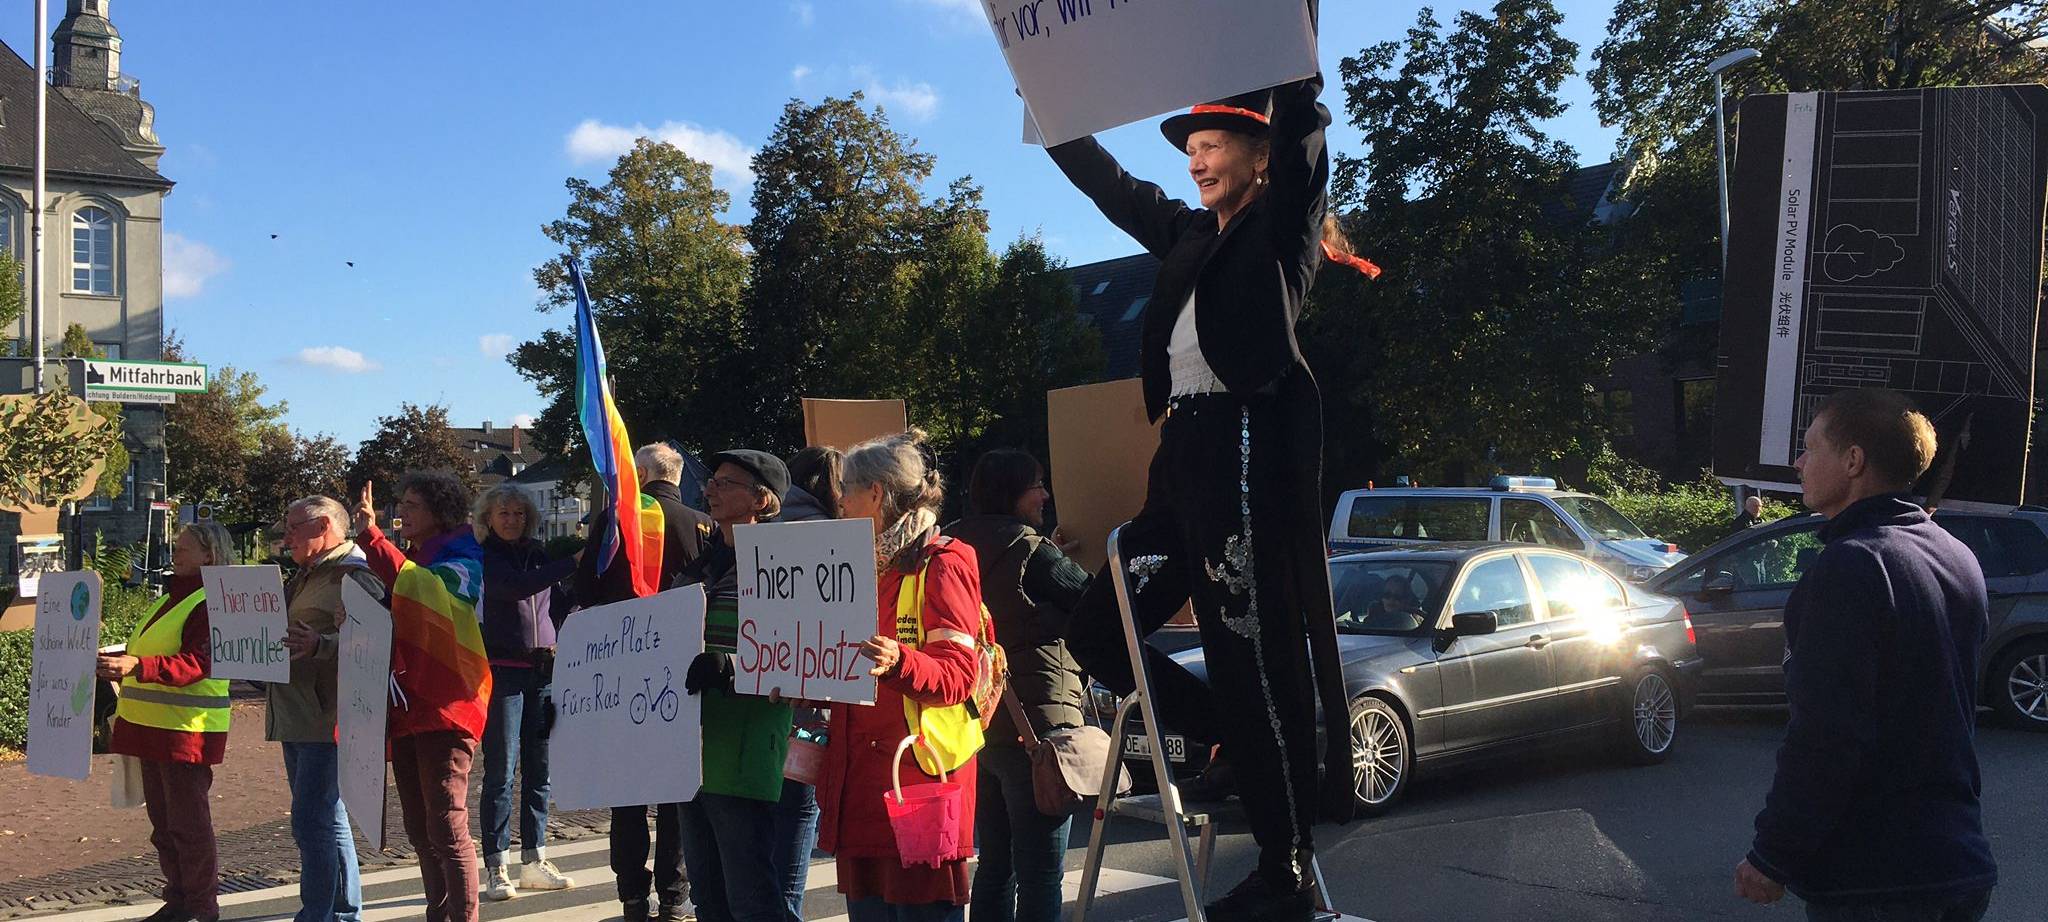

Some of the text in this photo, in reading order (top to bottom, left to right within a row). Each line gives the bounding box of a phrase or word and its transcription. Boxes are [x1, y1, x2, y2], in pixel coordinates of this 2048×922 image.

[1011, 0, 1050, 41] vor,
[1782, 188, 1801, 281] Solar PV Module
[1776, 291, 1792, 339] 光伏组件
[110, 366, 202, 386] Mitfahrbank
[815, 548, 855, 603] ein
[42, 591, 61, 614] Eine
[253, 585, 281, 614] eine
[67, 624, 91, 651] Welt
[212, 626, 285, 667] Baumallee
[621, 614, 661, 655] Platz
[740, 619, 865, 699] Spielplatz
[592, 672, 621, 712] Rad
[46, 702, 72, 729] Kinder
